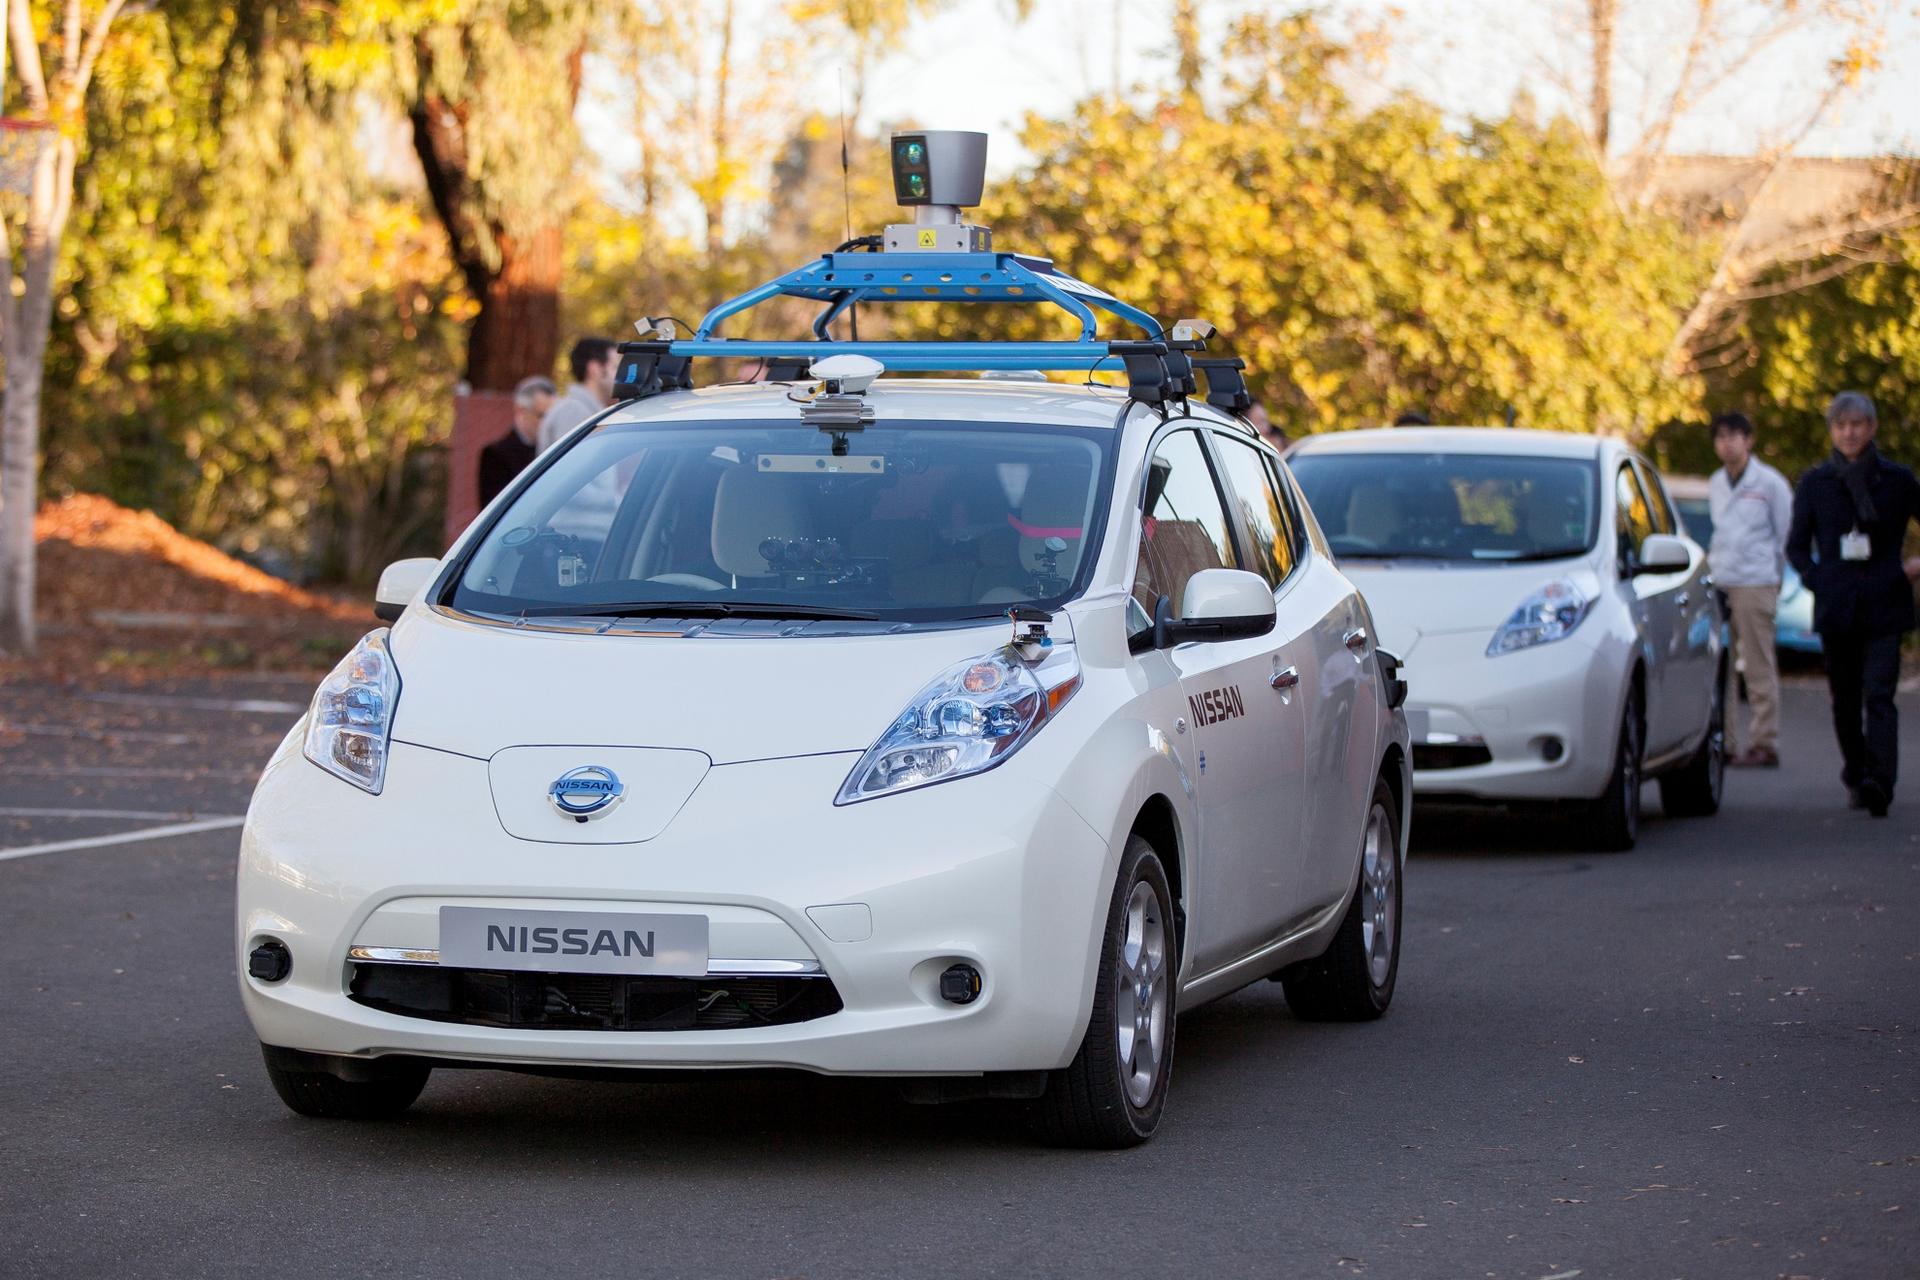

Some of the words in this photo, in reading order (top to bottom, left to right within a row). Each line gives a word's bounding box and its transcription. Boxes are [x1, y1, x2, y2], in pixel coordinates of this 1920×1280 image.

[1188, 685, 1245, 728] NISSAN
[555, 781, 614, 791] NISSAN
[487, 925, 655, 957] NISSAN
